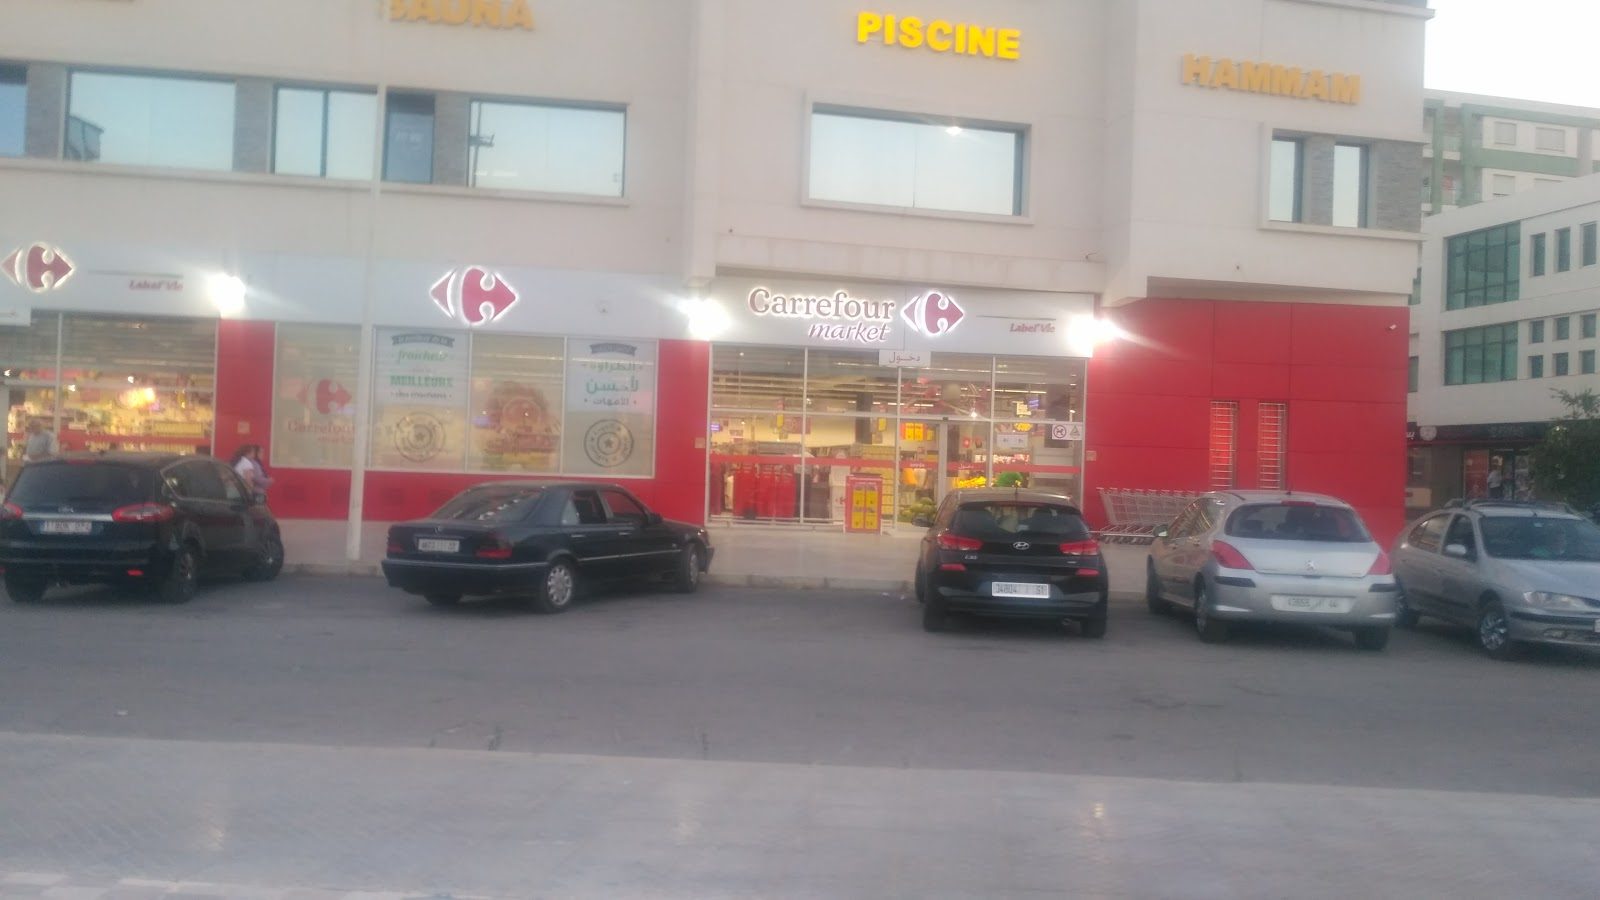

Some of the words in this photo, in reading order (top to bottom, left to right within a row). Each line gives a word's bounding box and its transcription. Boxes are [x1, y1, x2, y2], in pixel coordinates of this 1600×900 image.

[857, 11, 1021, 60] PISCINE
[1180, 53, 1361, 105] HAMMAM
[749, 287, 895, 320] Carrefour
[808, 322, 889, 343] market
